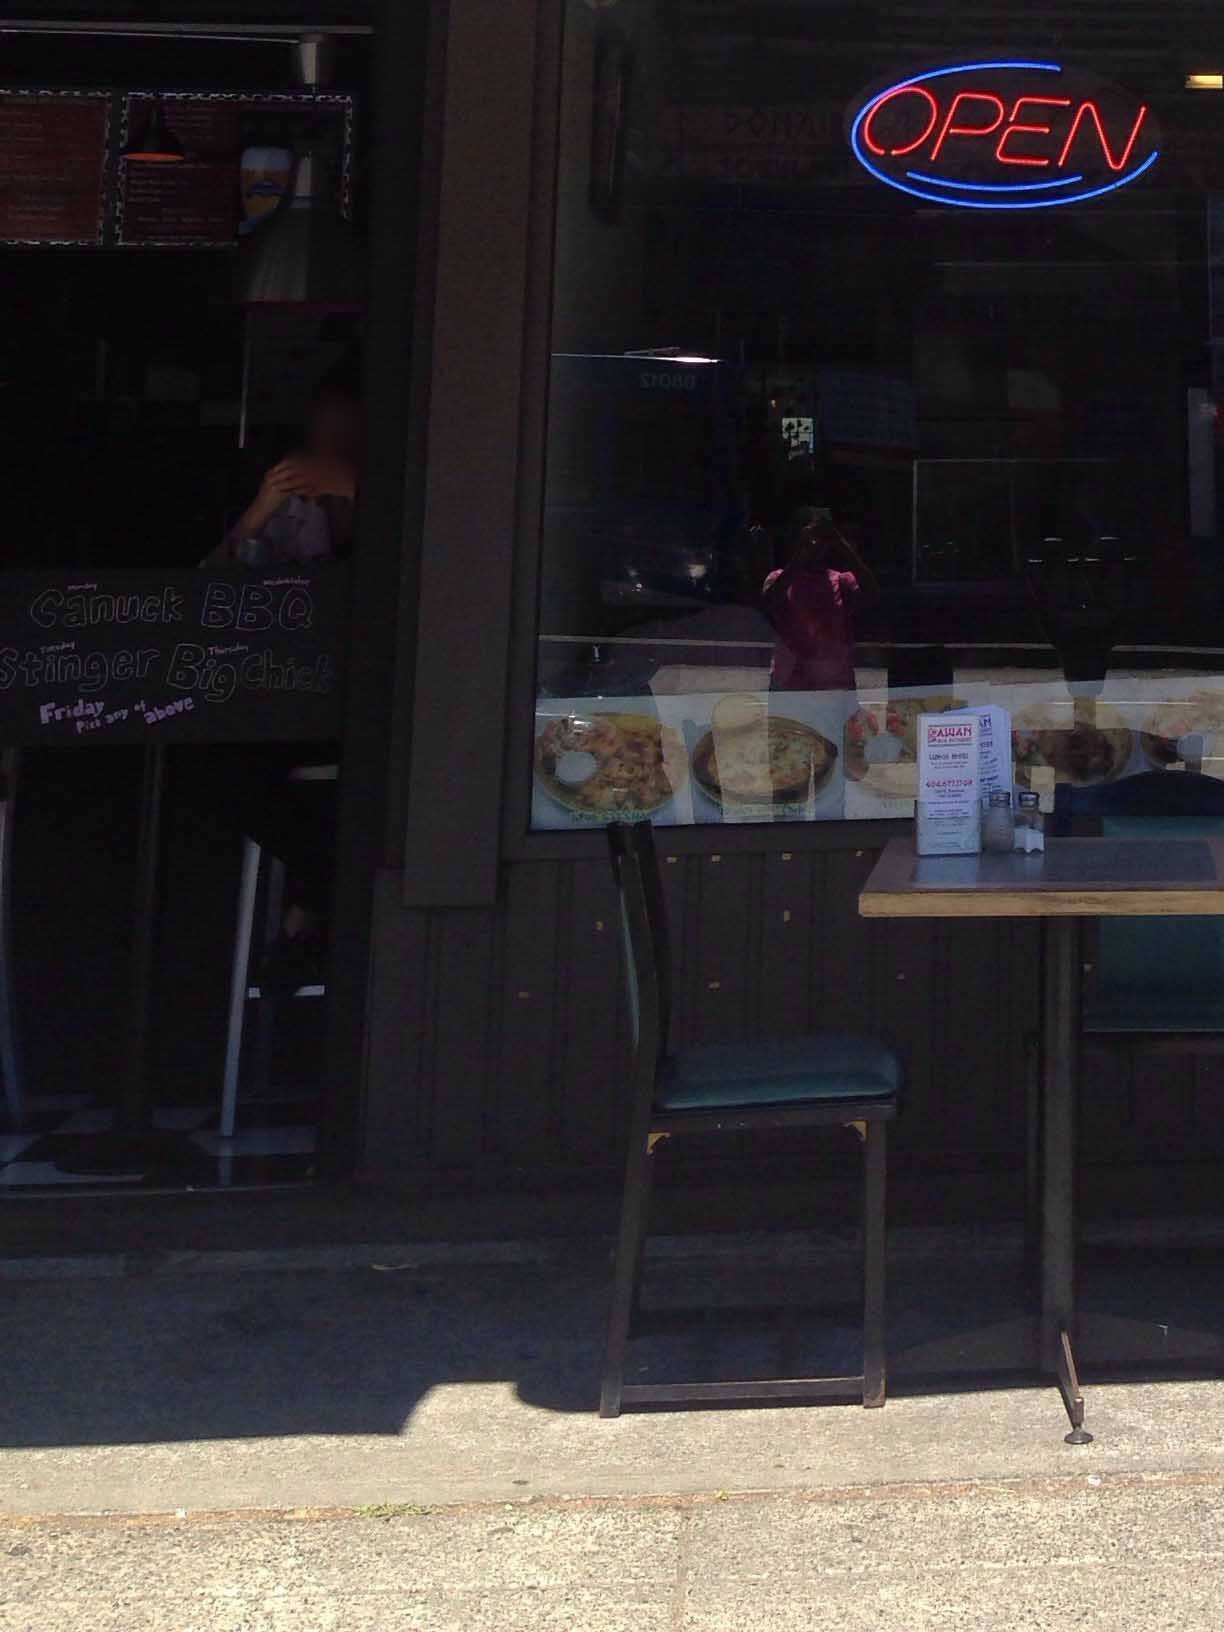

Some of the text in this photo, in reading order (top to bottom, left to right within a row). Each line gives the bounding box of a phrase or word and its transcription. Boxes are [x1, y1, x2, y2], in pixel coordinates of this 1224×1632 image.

[863, 86, 1148, 172] OPEN
[29, 582, 314, 632] Canuck BBQ
[0, 647, 161, 693] Stinger
[166, 642, 237, 703] Big
[39, 698, 105, 724] Friday
[143, 695, 195, 725] above
